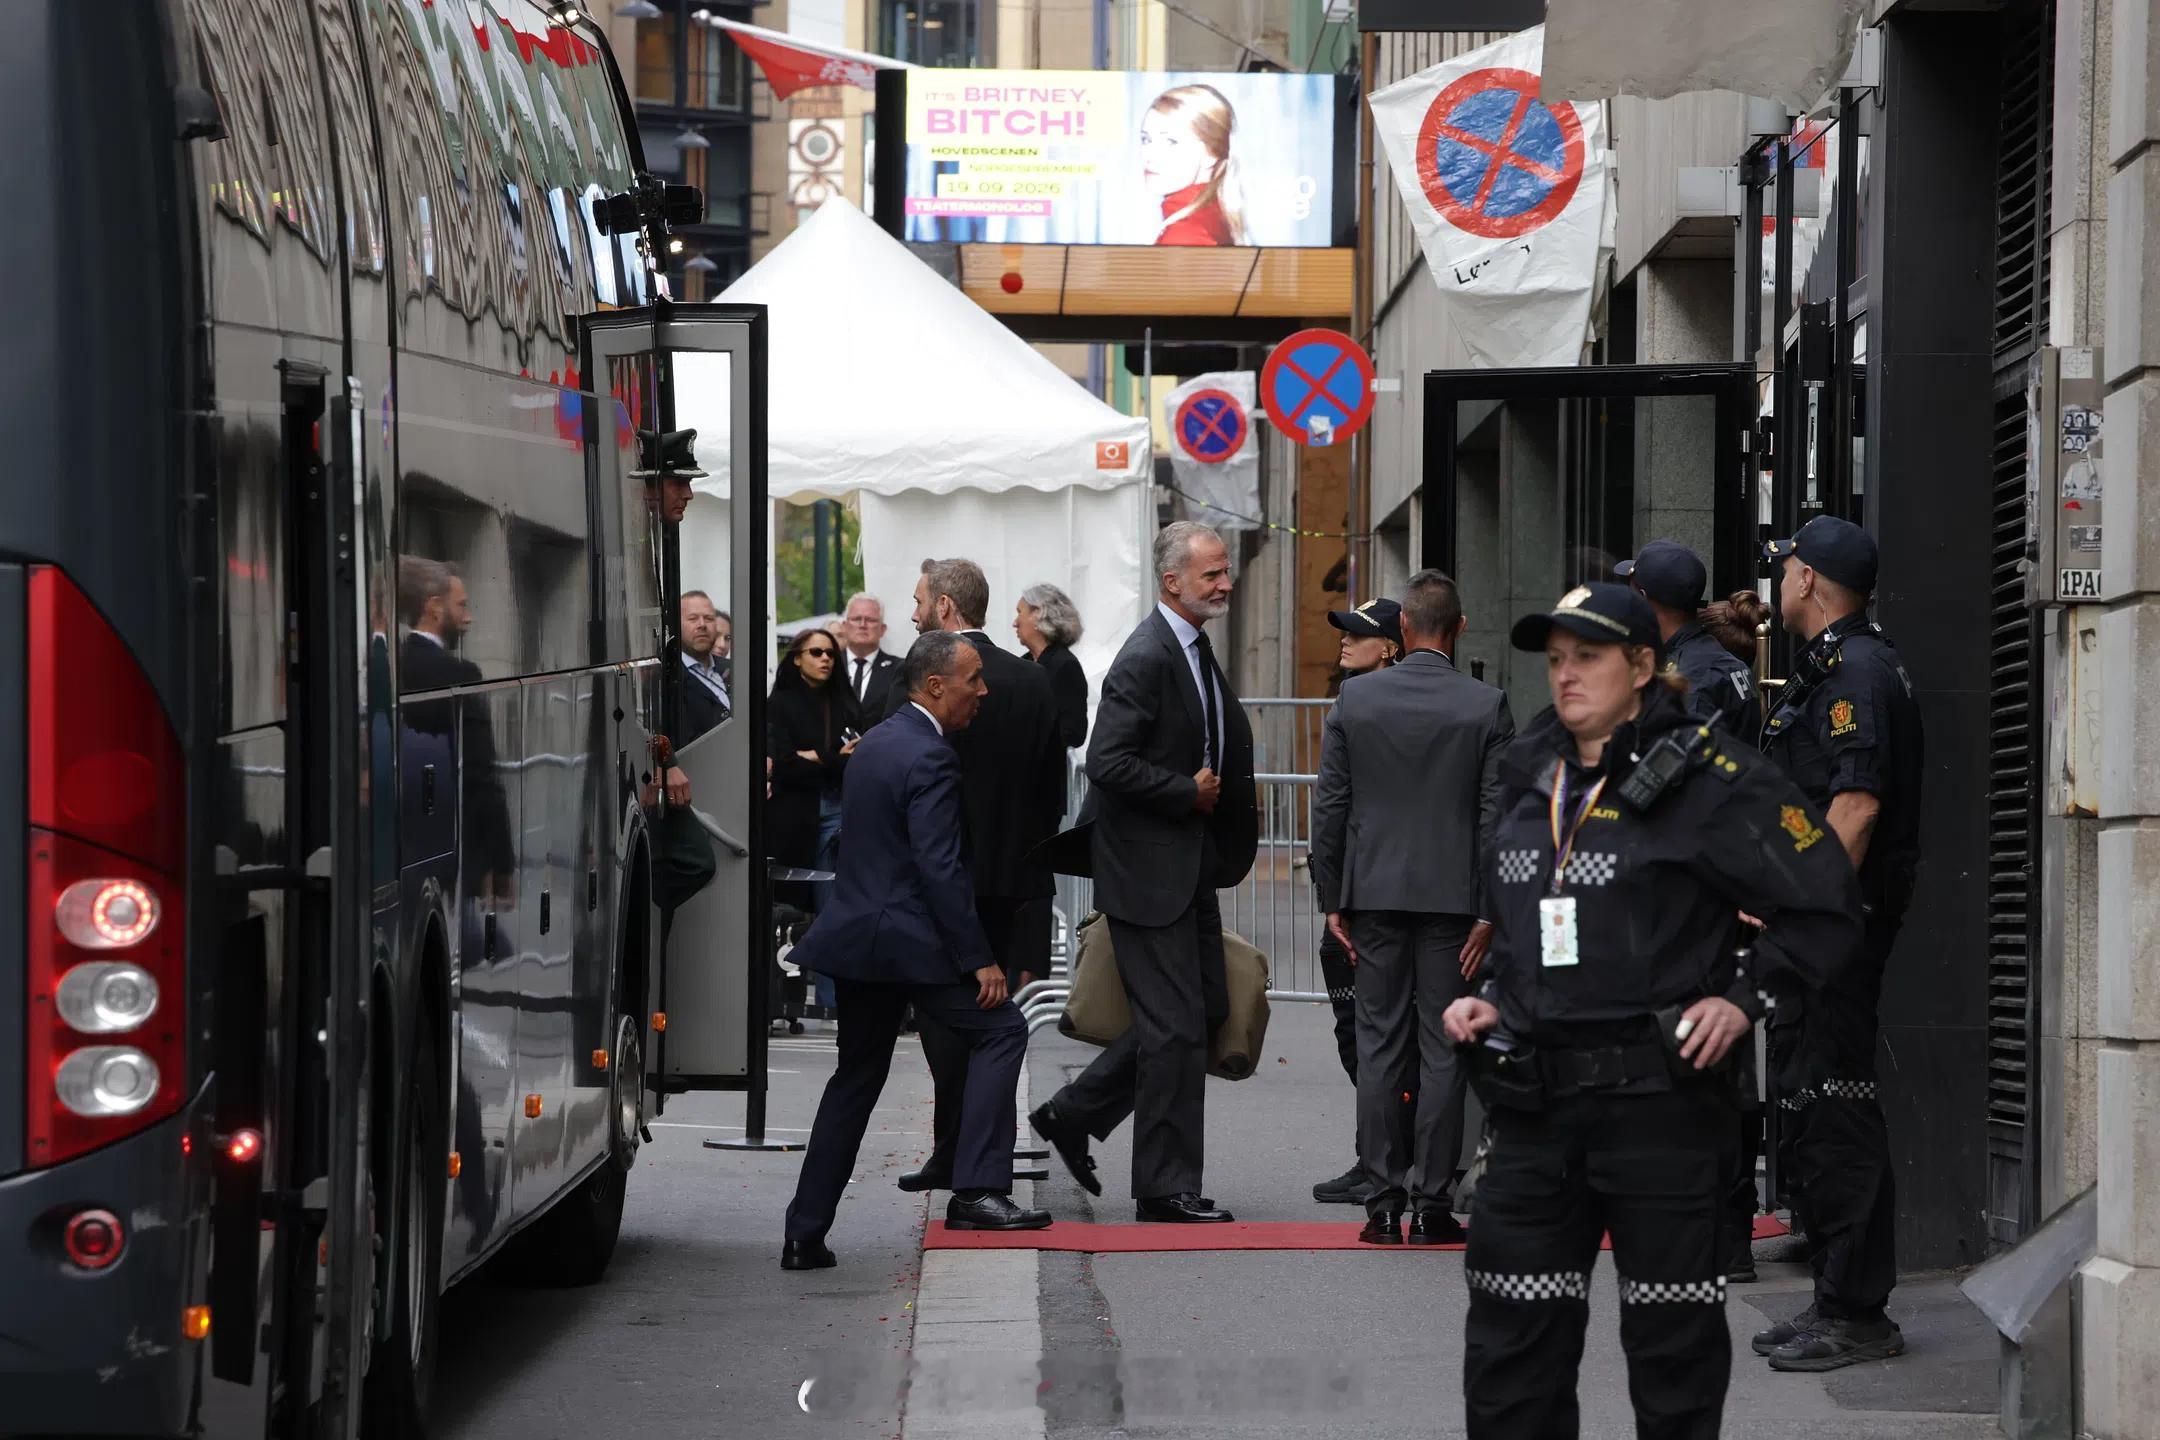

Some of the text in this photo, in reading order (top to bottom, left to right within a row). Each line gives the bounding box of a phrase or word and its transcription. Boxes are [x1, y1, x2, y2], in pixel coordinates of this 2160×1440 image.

[926, 87, 1091, 106] IT'S BRITNEY,
[927, 109, 1086, 136] BITCH!
[931, 147, 1038, 156] HOVEDSCENEN
[914, 201, 1044, 214] TEATERMONOLOG
[1831, 723, 1857, 738] POLITI
[1794, 828, 1825, 853] POLITI
